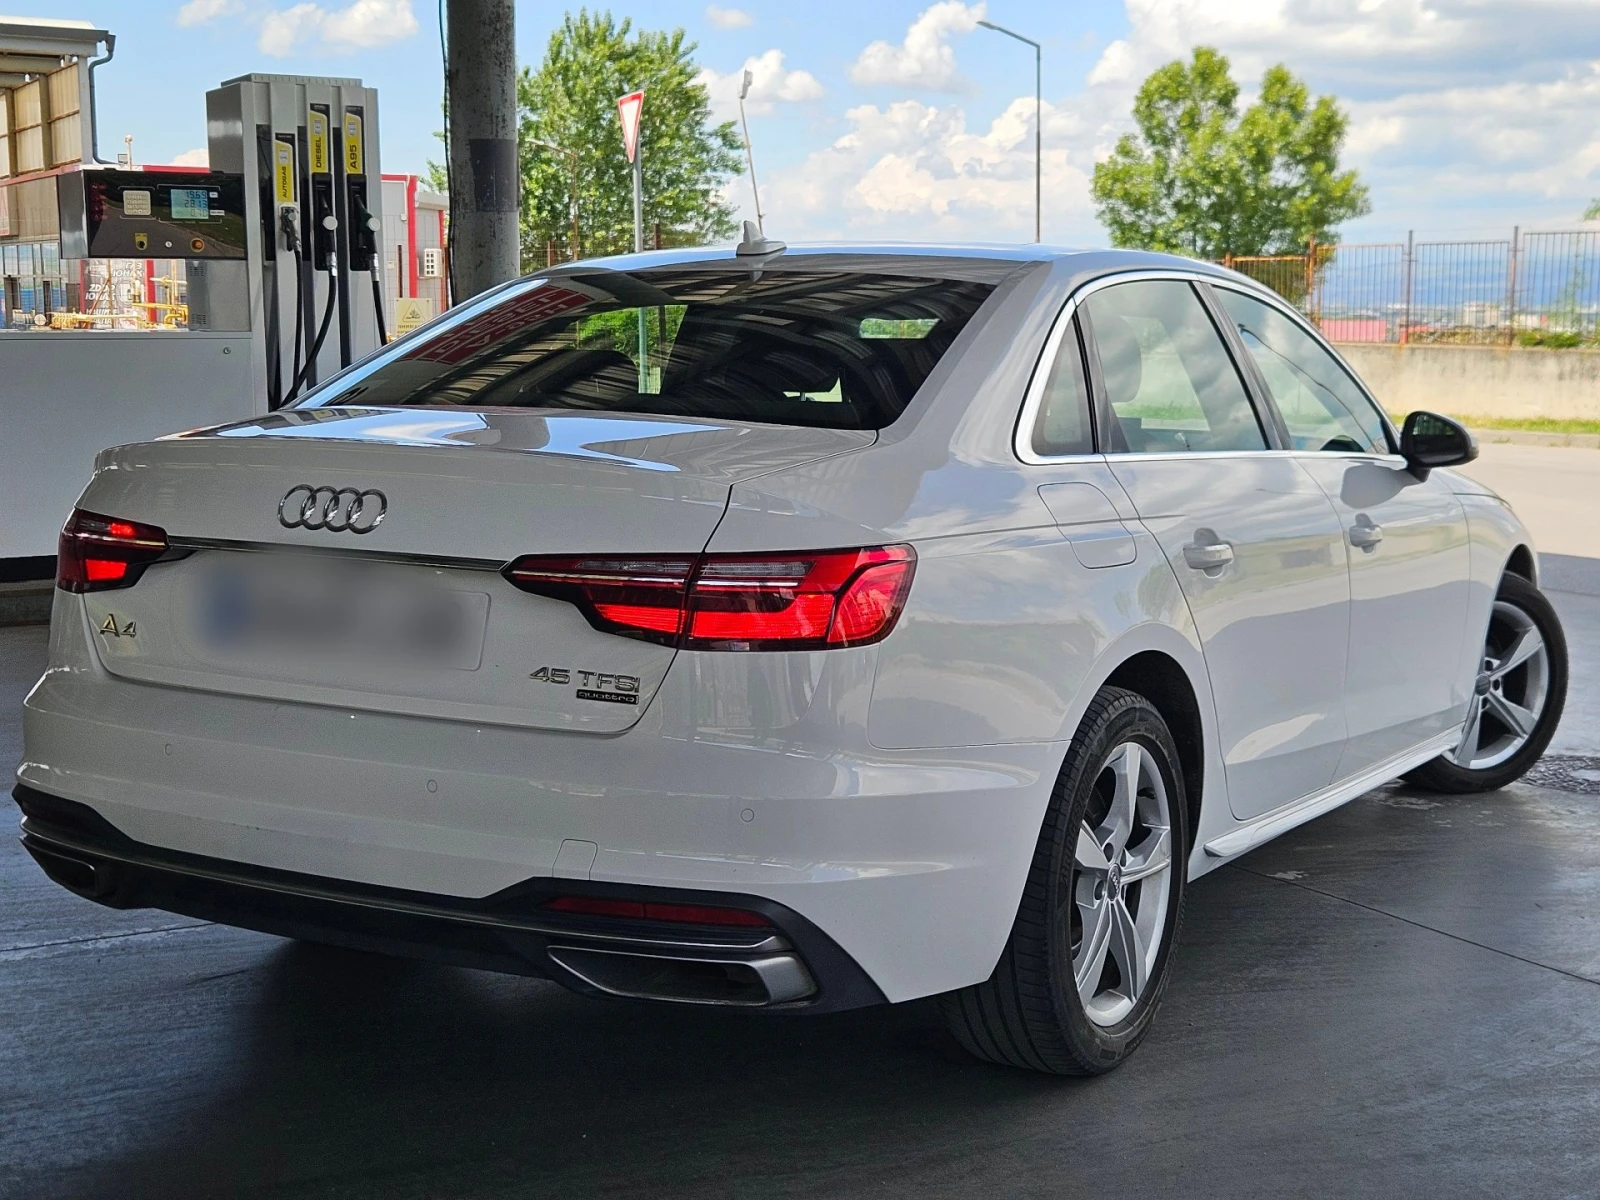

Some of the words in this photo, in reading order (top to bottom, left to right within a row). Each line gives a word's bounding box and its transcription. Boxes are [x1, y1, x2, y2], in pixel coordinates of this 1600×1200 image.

[349, 144, 358, 169] A95
[99, 613, 137, 638] A4
[529, 666, 571, 685] 45
[577, 669, 641, 693] TFSI
[577, 690, 636, 704] quattro
